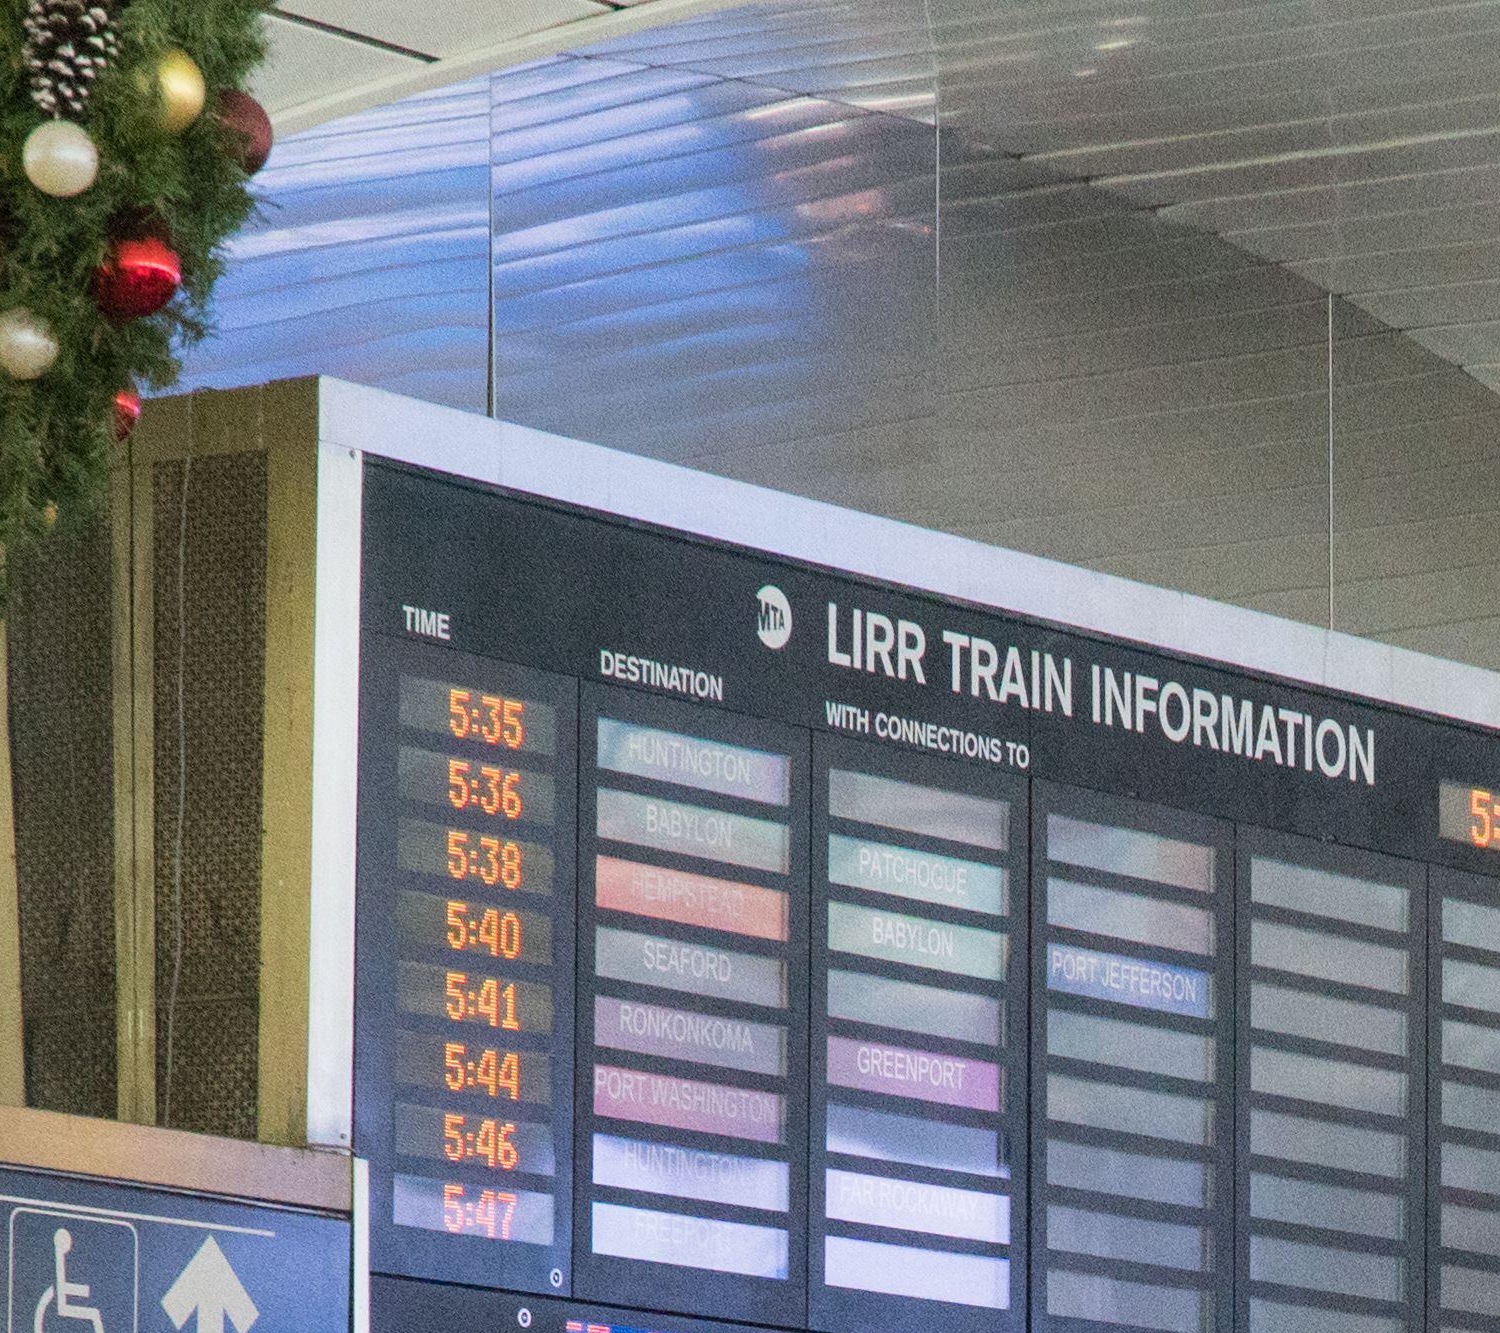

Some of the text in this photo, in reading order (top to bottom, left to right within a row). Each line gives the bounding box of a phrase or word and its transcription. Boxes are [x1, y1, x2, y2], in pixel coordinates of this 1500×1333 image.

[402, 603, 451, 640] TIME
[601, 649, 723, 699] DESTINATION
[828, 603, 1375, 785] LIRR TRAIN INFORMATION
[448, 688, 524, 750] 5:35
[826, 701, 1030, 769] WITH CONNECTIONS TO
[630, 733, 751, 782] HUNTINGTON
[448, 759, 522, 819] 5:36
[645, 805, 732, 848] BABYLON
[447, 831, 522, 889] 5:38
[859, 848, 967, 895] PATCHOGUE
[631, 867, 744, 918] HEMPSTEAD
[446, 901, 521, 959] 5:40
[872, 915, 954, 959] BABYLON
[643, 942, 731, 983] SEAFORD
[1051, 950, 1197, 1002] PORT JEFFERSON
[445, 972, 519, 1031] 5:41
[620, 1003, 753, 1054] RONKONKOMA
[445, 1042, 519, 1101] 5:44
[858, 1046, 966, 1091] GREENPORT
[595, 1068, 776, 1124] PORT WASHINGTON
[444, 1113, 517, 1169] 5:46
[443, 1183, 517, 1240] 5:47
[840, 1175, 877, 1209] FAR
